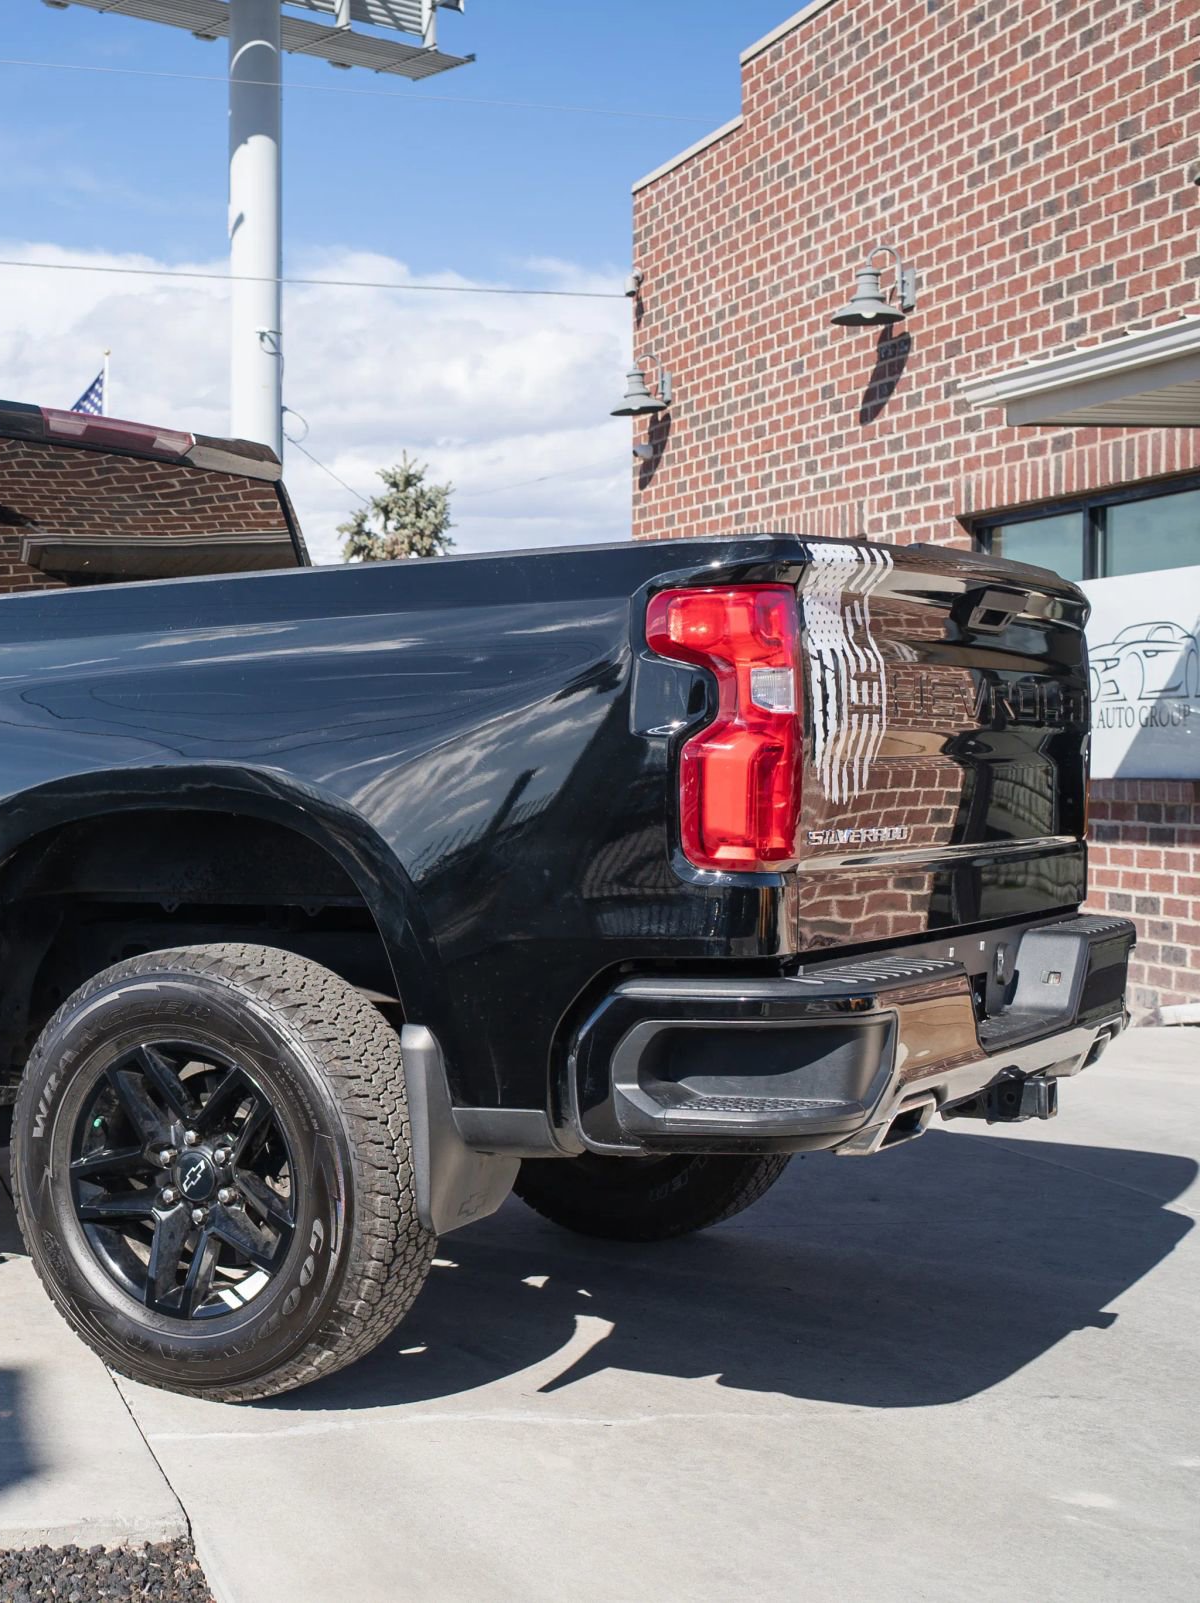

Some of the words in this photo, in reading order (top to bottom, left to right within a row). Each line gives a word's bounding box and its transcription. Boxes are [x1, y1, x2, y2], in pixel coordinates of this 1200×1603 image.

[1096, 705, 1135, 729] AUTO
[1138, 704, 1191, 729] GROUP
[806, 825, 908, 846] SILVERADO
